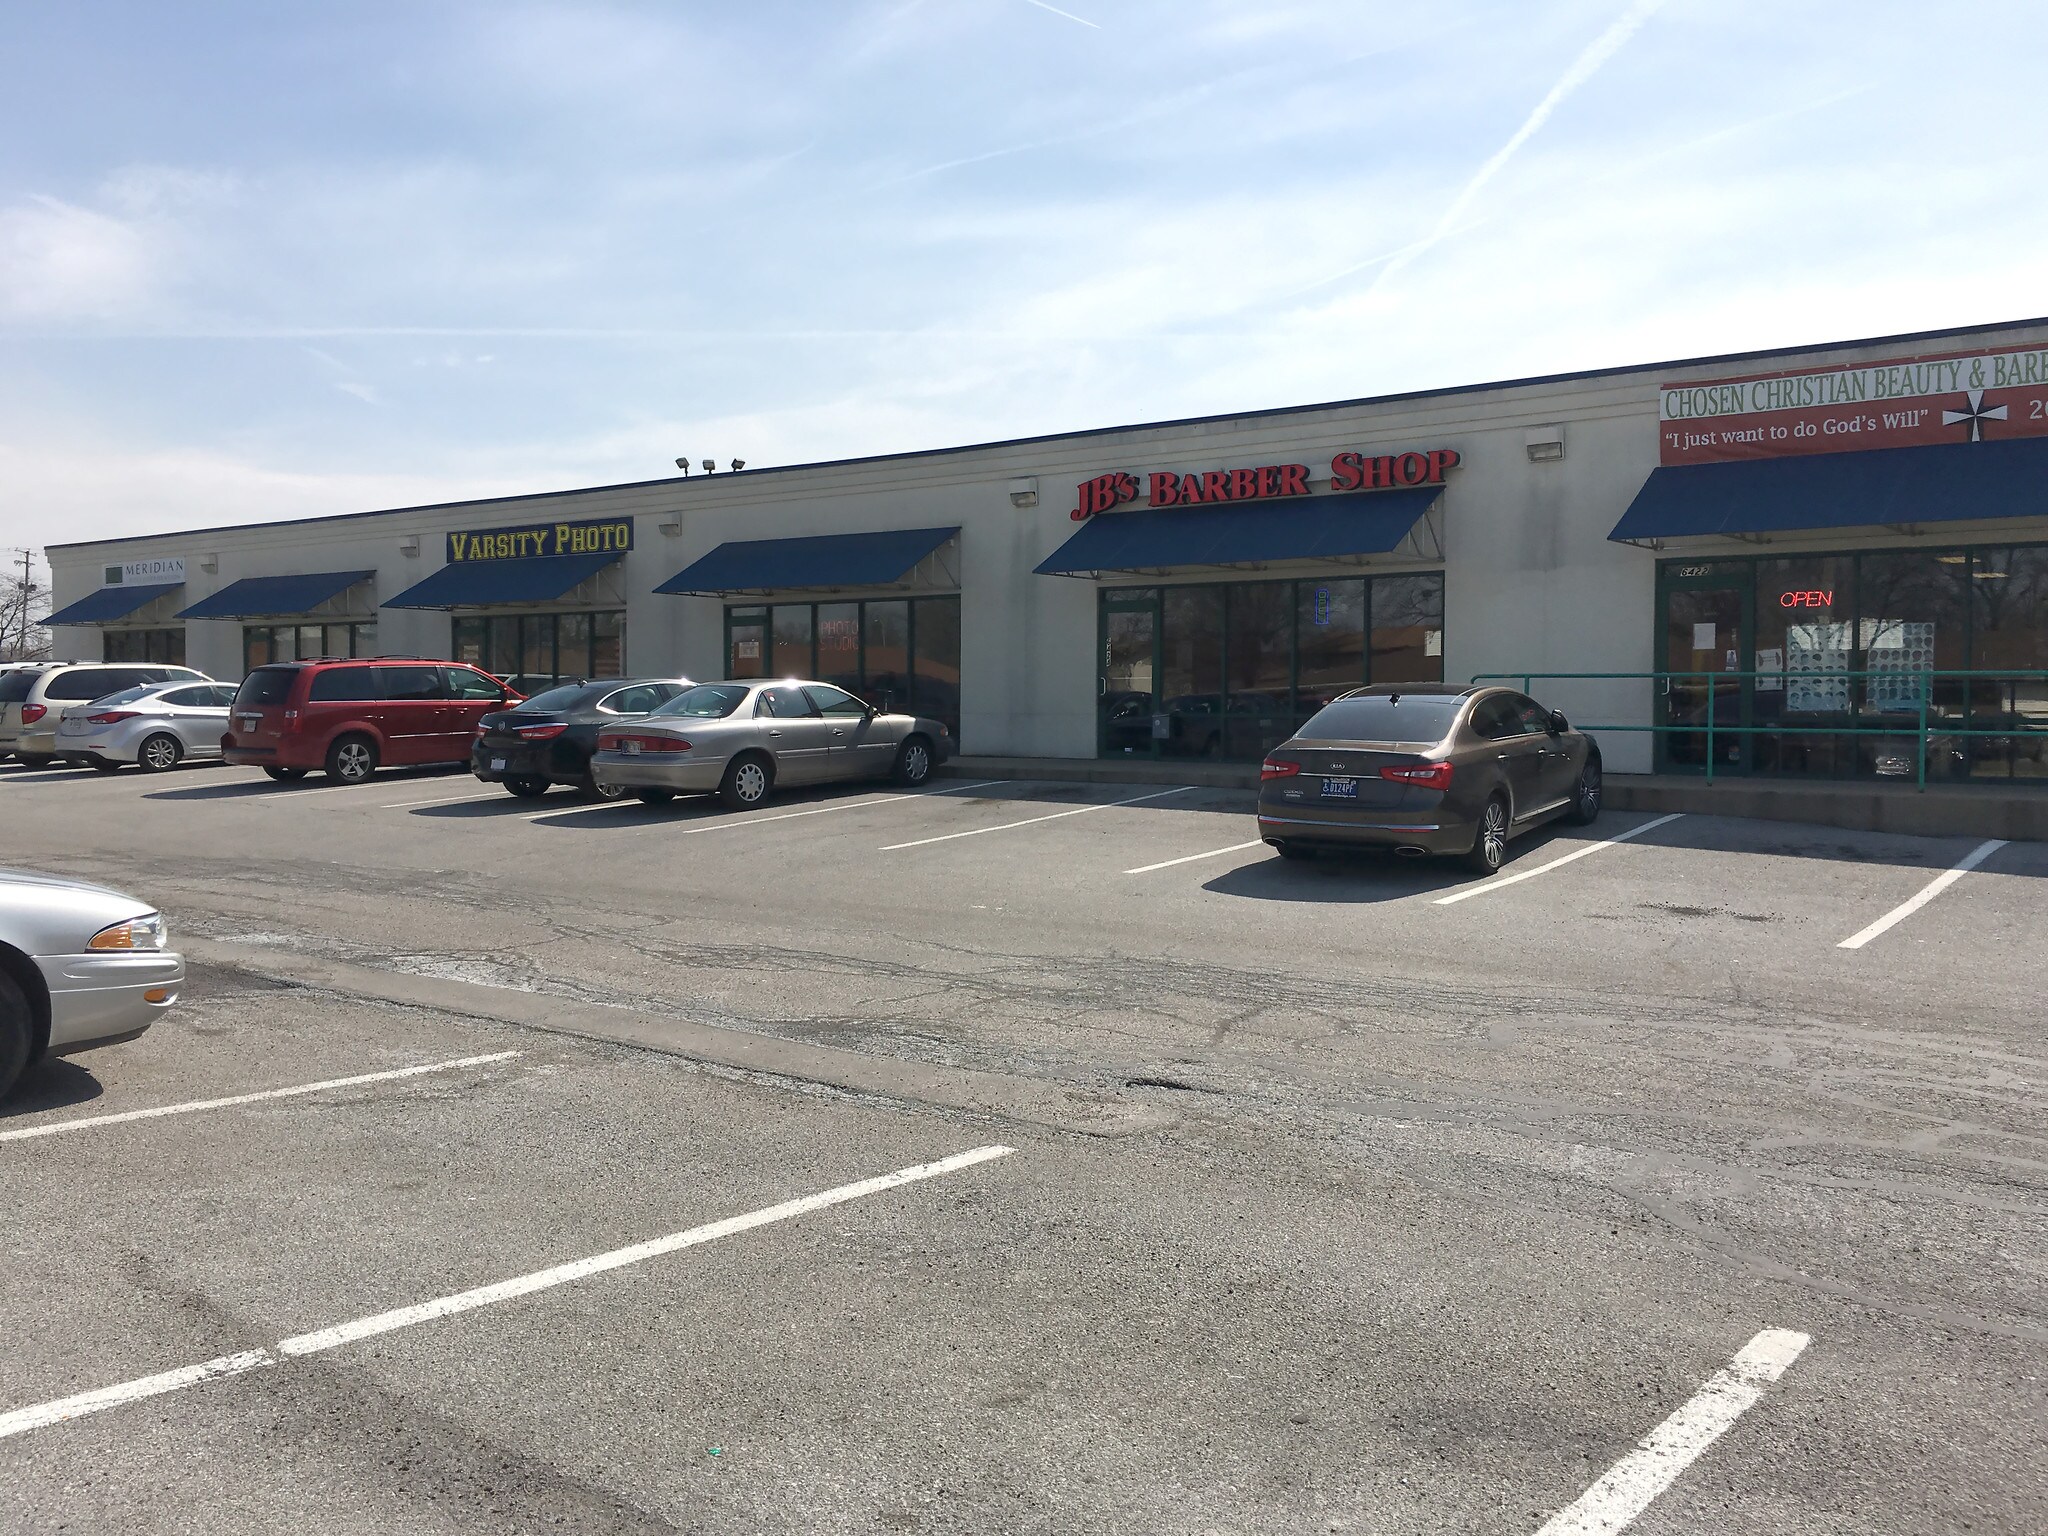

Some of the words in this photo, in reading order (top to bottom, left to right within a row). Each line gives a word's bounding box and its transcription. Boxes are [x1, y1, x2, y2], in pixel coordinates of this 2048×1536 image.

[1664, 383, 1745, 420] CHOSEN
[1750, 369, 1868, 412] CHRISTIAN
[1873, 359, 1963, 398] BEAUTY
[1968, 356, 1986, 389] &
[2029, 399, 2048, 420] 2
[1682, 429, 1717, 451] just
[1720, 427, 1765, 444] want
[1769, 424, 1788, 440] to
[1792, 420, 1817, 438] do
[1822, 414, 1877, 436] God's
[1147, 462, 1312, 508] BARBER
[1330, 448, 1461, 492] SHOP
[450, 530, 549, 562] VARSITY
[554, 524, 632, 555] PHOTO
[125, 560, 184, 576] MERIDIAN
[1780, 589, 1834, 608] OPEN
